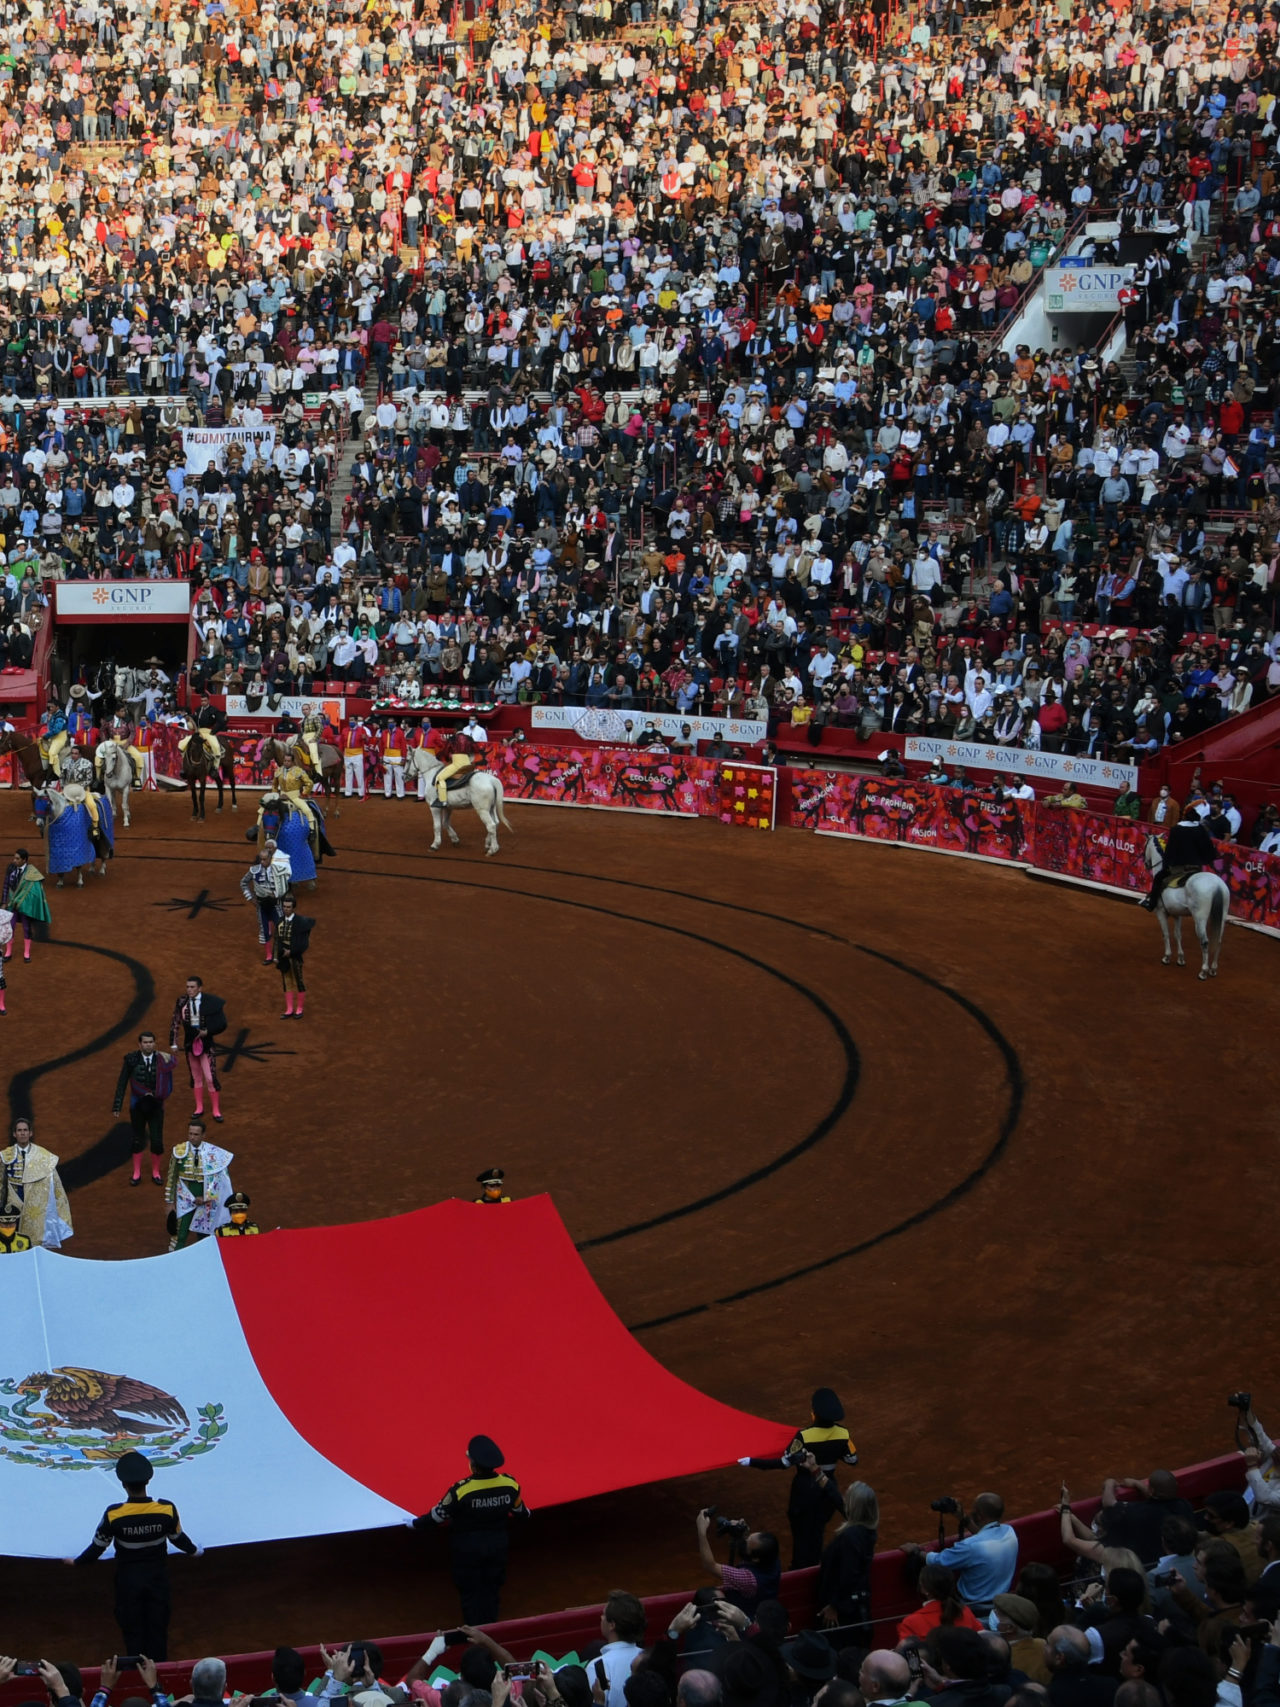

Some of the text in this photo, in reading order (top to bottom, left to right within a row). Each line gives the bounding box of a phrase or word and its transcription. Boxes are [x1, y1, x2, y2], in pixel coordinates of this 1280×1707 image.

[1079, 273, 1121, 290] GNP
[186, 431, 271, 444] #CDMXTAURINA
[111, 588, 151, 603] GNP
[279, 702, 302, 711] GNP
[702, 721, 725, 733] GNP
[739, 724, 762, 735] GNP
[918, 741, 941, 753] GNP
[957, 746, 981, 758] GNP
[996, 751, 1019, 763] GNP
[1035, 756, 1058, 769] GNP
[1073, 763, 1097, 775] GNP
[1111, 768, 1134, 780] GNP
[881, 796, 916, 814] PROHIBIR
[980, 799, 1007, 816] FIESTA
[1091, 833, 1135, 854] CABALLOS
[471, 1494, 511, 1509] TRANSITO
[122, 1523, 162, 1536] TRANSITO
